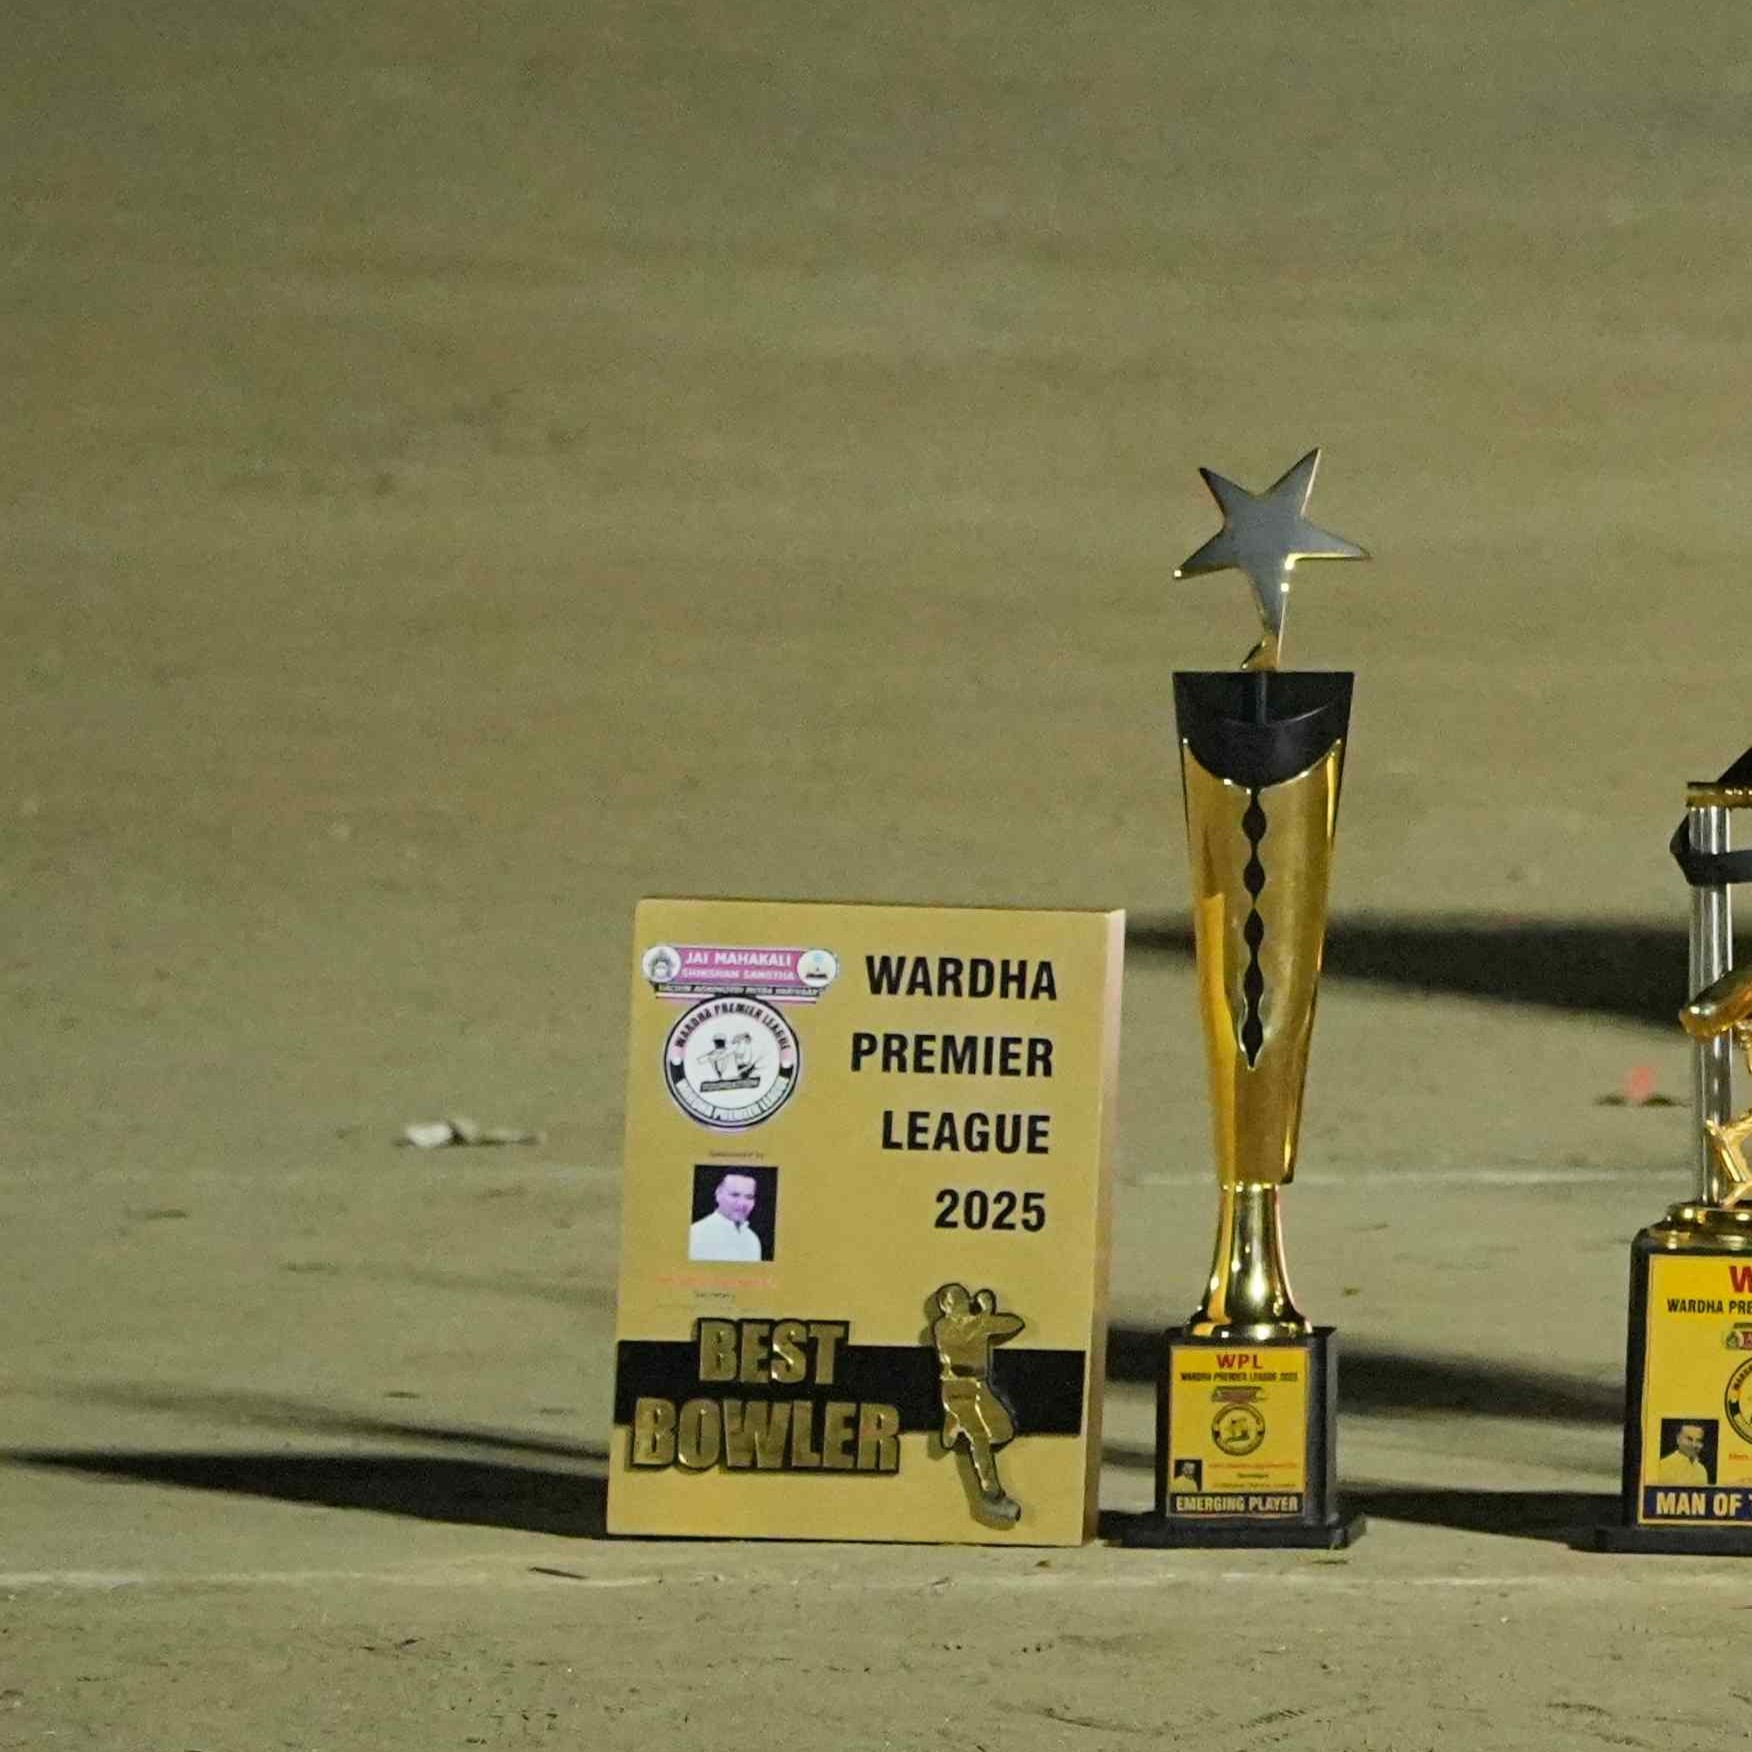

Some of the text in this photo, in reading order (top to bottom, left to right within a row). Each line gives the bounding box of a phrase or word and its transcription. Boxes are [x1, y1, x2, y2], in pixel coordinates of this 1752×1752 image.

[685, 951, 793, 968] JAI MAHAKALI
[865, 954, 1058, 1001] WARDHA
[674, 1008, 712, 1048] WARDHA
[713, 1002, 763, 1021] PREMIER
[850, 1032, 1054, 1078] PREMIER
[881, 1110, 1051, 1155] LEAGUE
[933, 1188, 1046, 1233] 2025
[1667, 1299, 1724, 1314] WARDHA
[697, 1317, 851, 1386] BEST
[1216, 1354, 1263, 1369] WPL
[627, 1396, 901, 1474] BOWLER
[1176, 1496, 1299, 1513] EMERGING PLAYER
[1656, 1491, 1707, 1515] MAN
[1713, 1492, 1743, 1517] OF
